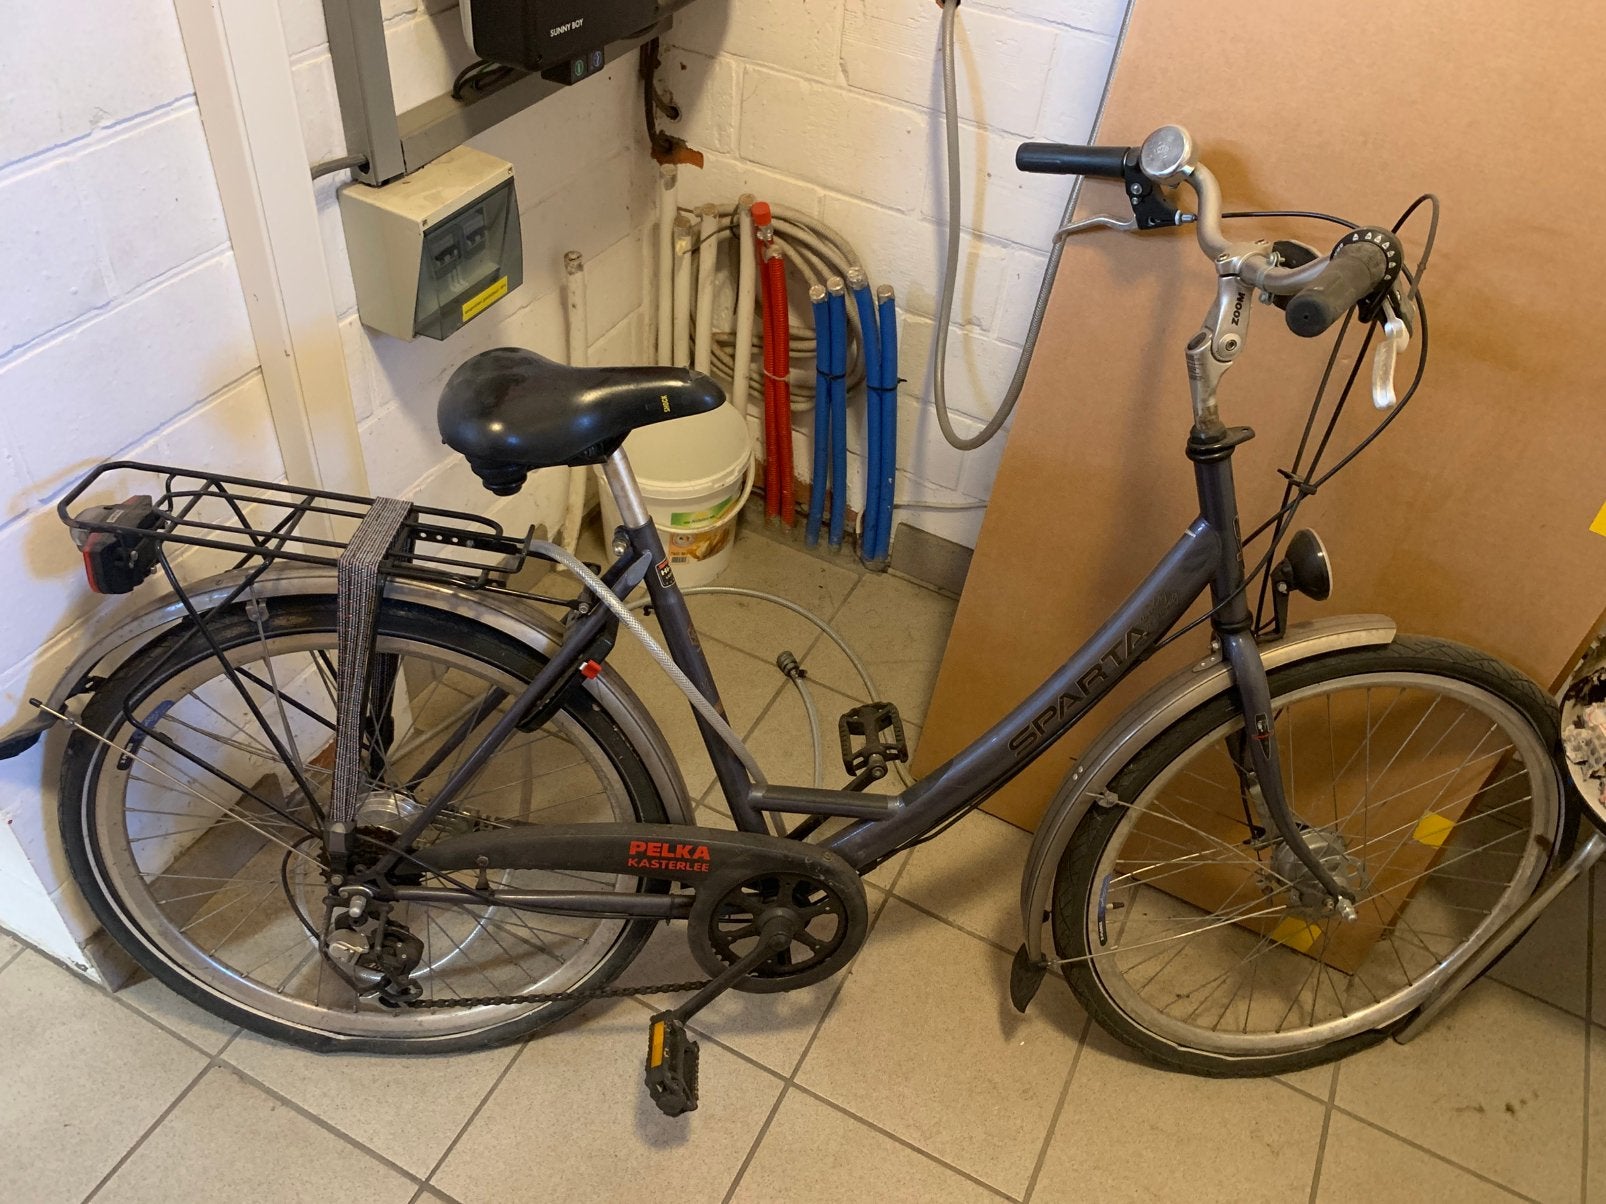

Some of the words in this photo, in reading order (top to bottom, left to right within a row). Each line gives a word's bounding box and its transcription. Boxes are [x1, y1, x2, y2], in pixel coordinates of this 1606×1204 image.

[550, 23, 571, 37] SUNNY
[572, 18, 584, 29] BOY
[1231, 292, 1246, 326] ZOOM
[1008, 627, 1149, 758] SPARTA
[629, 841, 710, 860] PELKA
[628, 858, 710, 871] KASTERLEE
